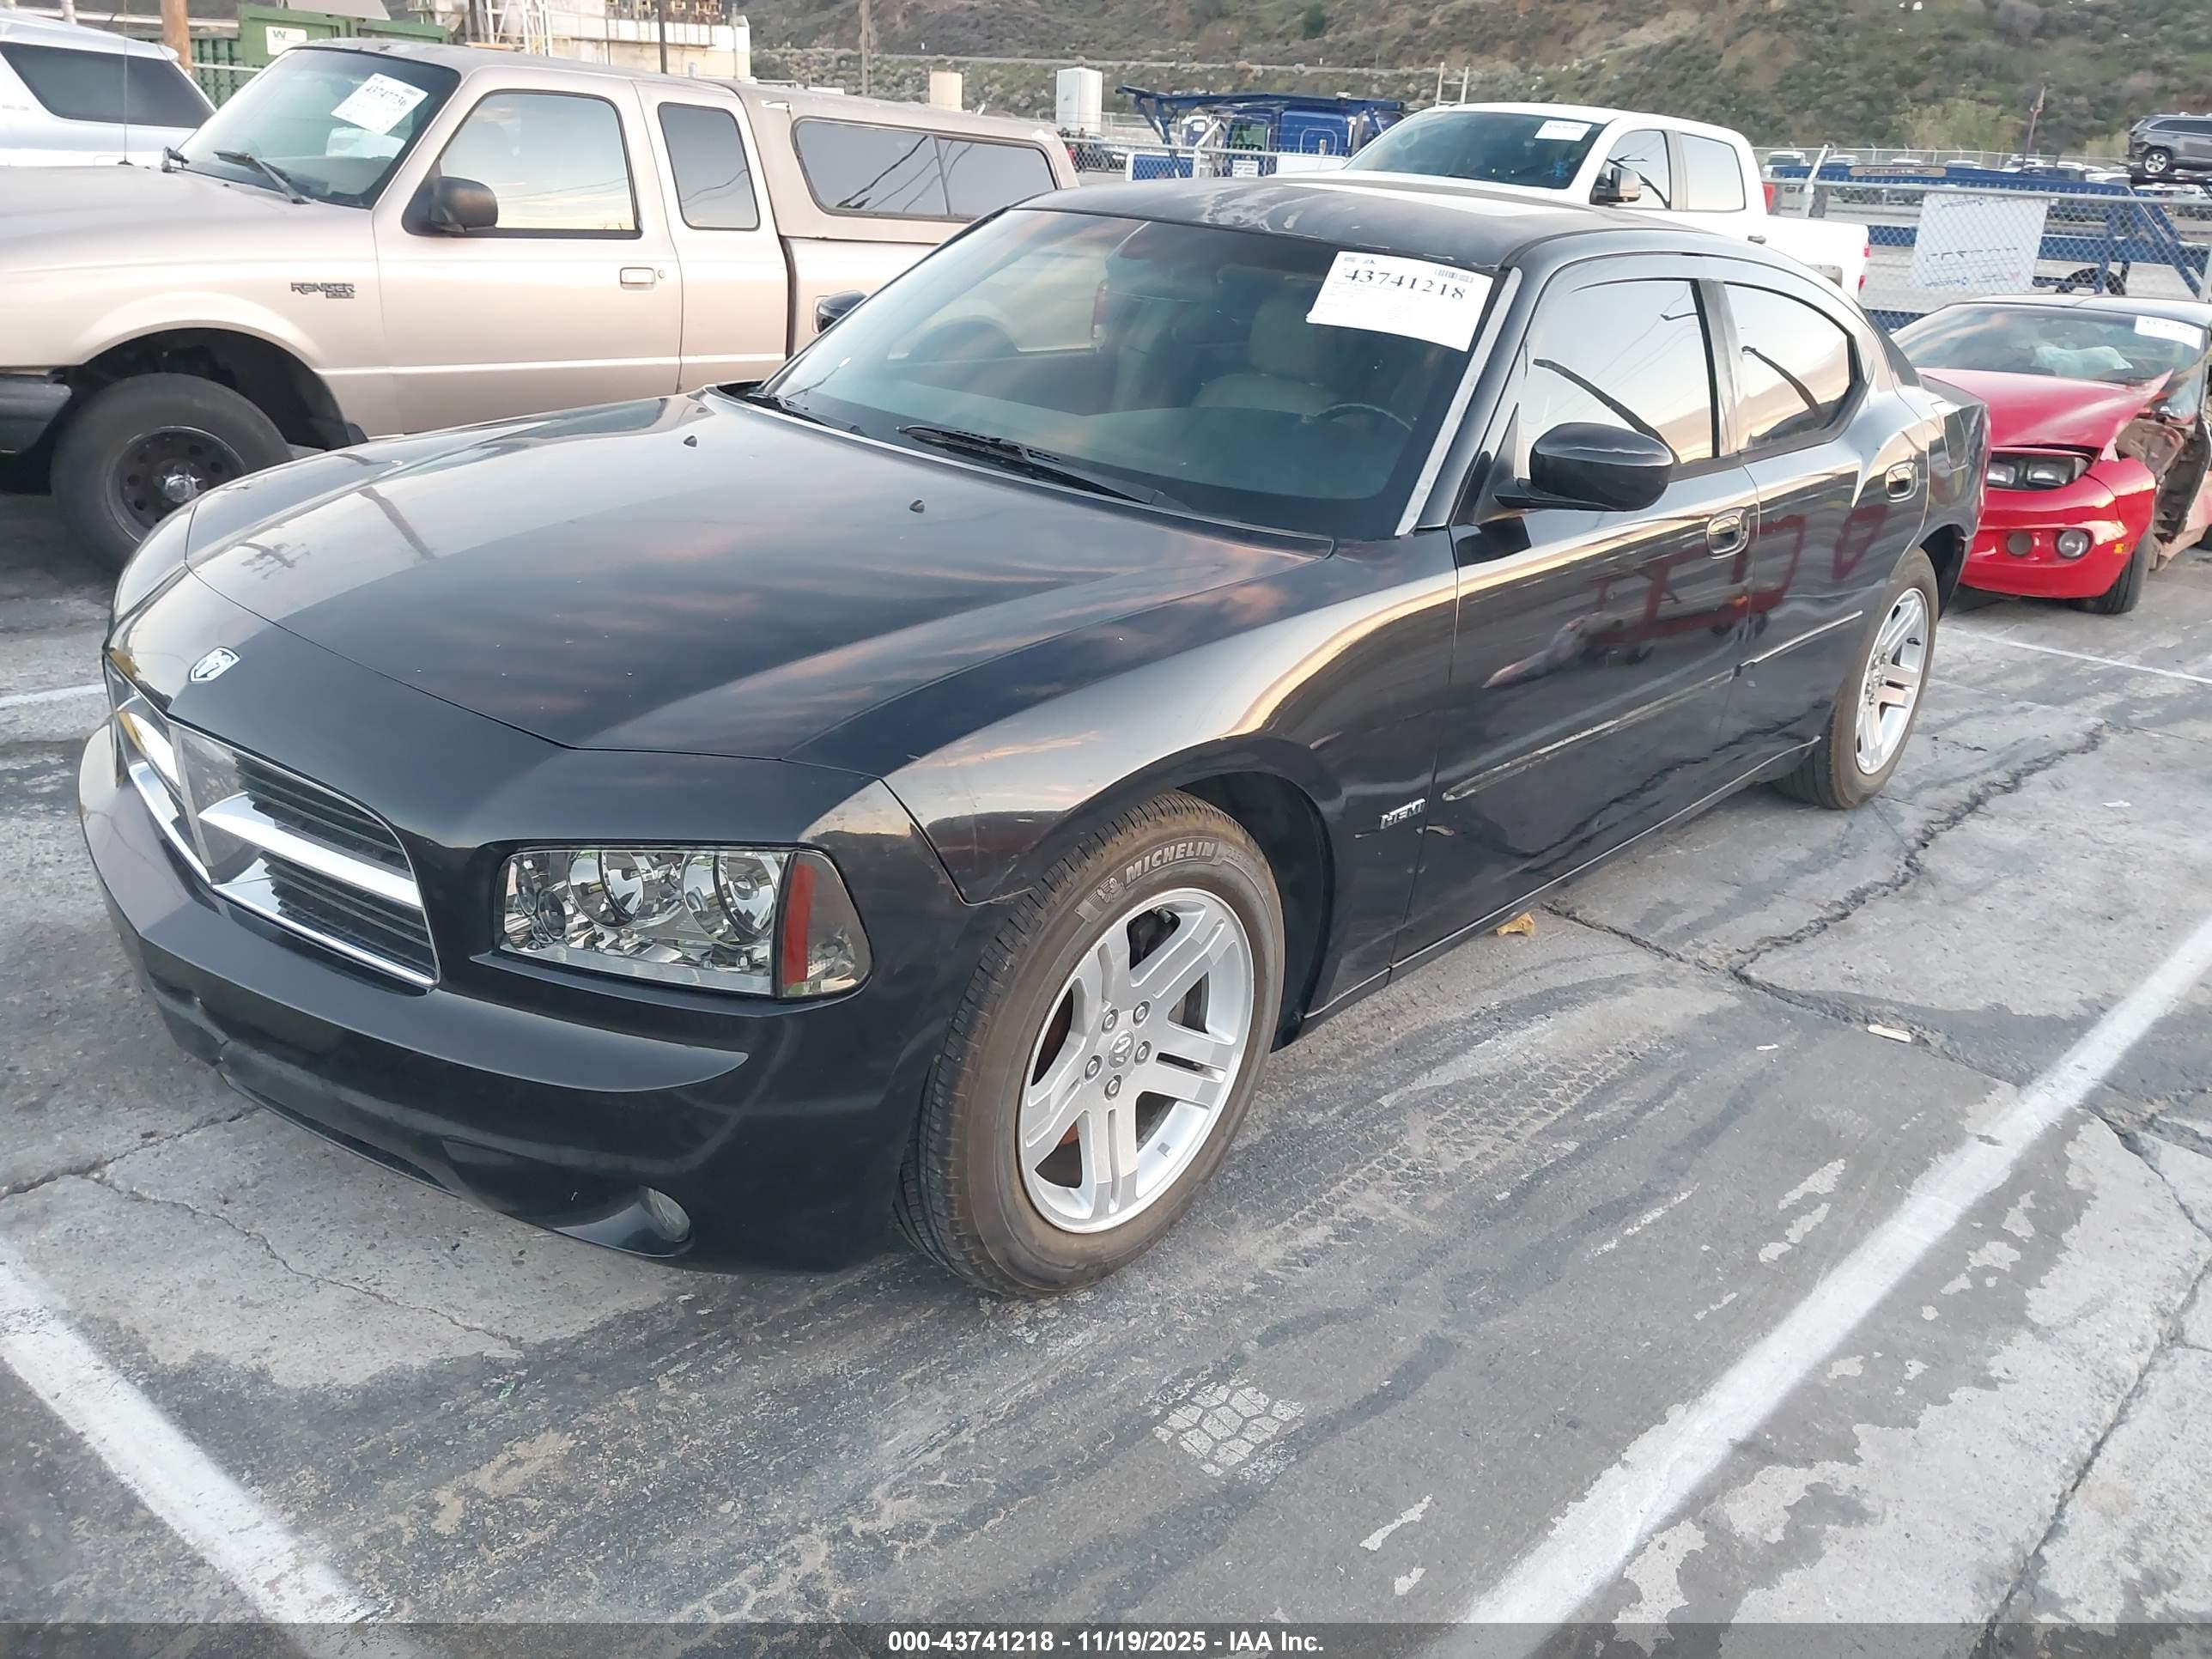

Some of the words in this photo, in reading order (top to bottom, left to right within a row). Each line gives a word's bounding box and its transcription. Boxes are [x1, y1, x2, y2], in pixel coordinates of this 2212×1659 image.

[290, 282, 356, 295] RANGER
[1344, 268, 1467, 301] 43741218
[1379, 798, 1426, 830] HEMI
[1125, 841, 1216, 884] MICHELIN
